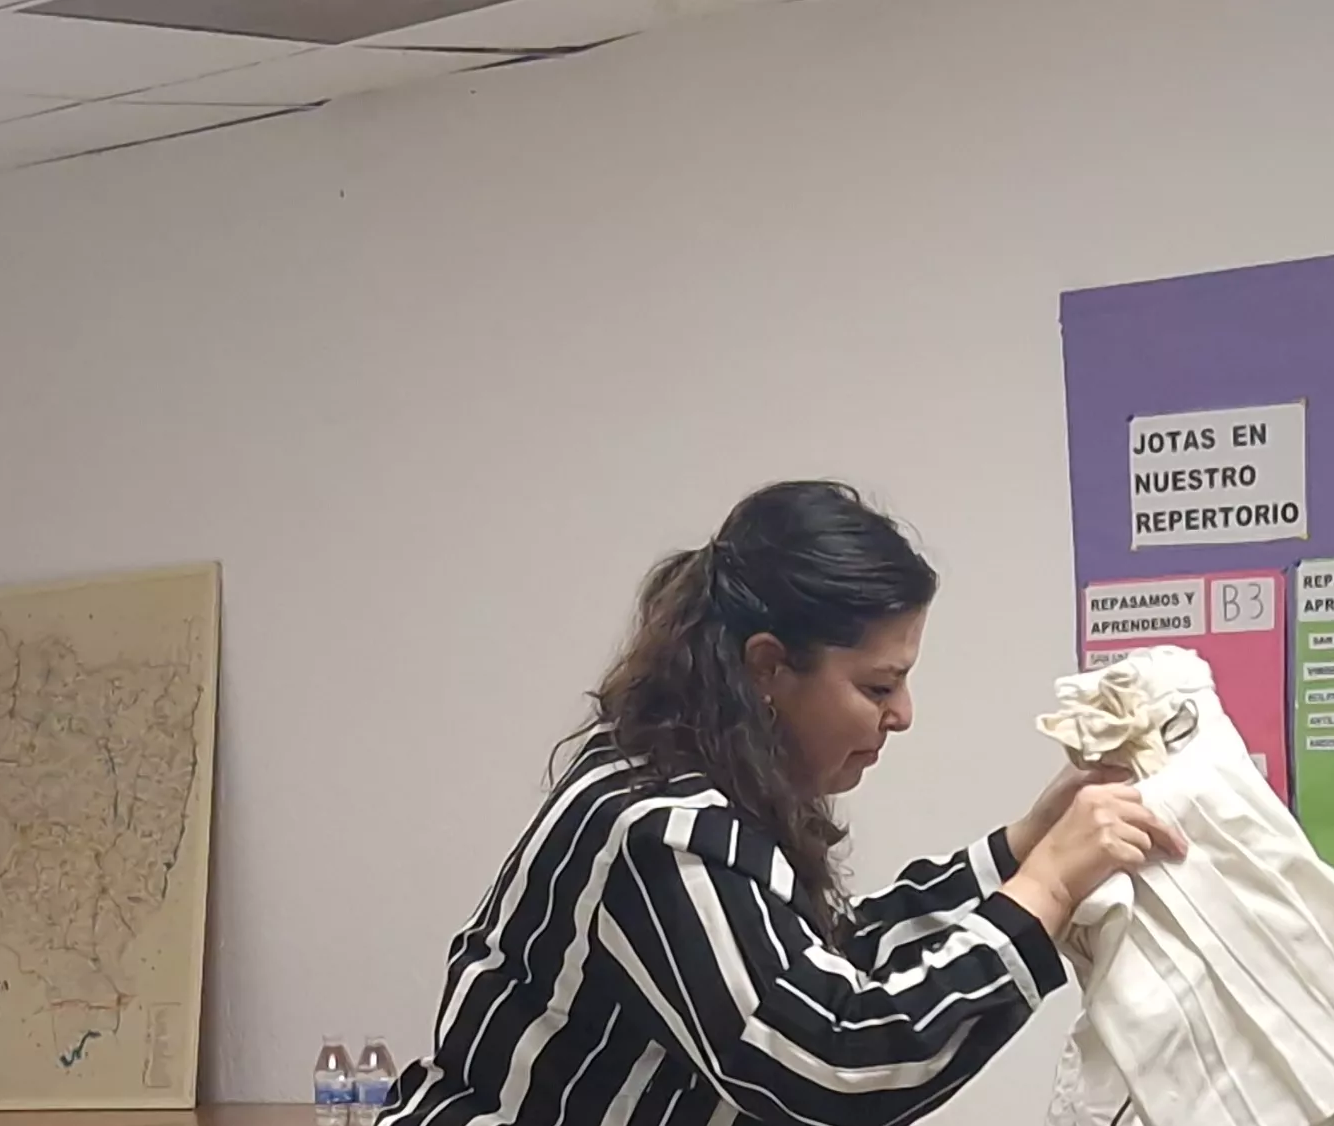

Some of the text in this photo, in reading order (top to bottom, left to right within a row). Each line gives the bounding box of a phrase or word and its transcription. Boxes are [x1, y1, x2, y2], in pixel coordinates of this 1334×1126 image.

[1133, 423, 1266, 455] JOTAS EN
[1135, 465, 1256, 495] NUESTRO
[1136, 502, 1299, 534] REPERTORIO
[1091, 592, 1195, 611] REPASAMOS Y
[1222, 584, 1264, 622] B3
[1091, 616, 1192, 634] APRENDEMOS
